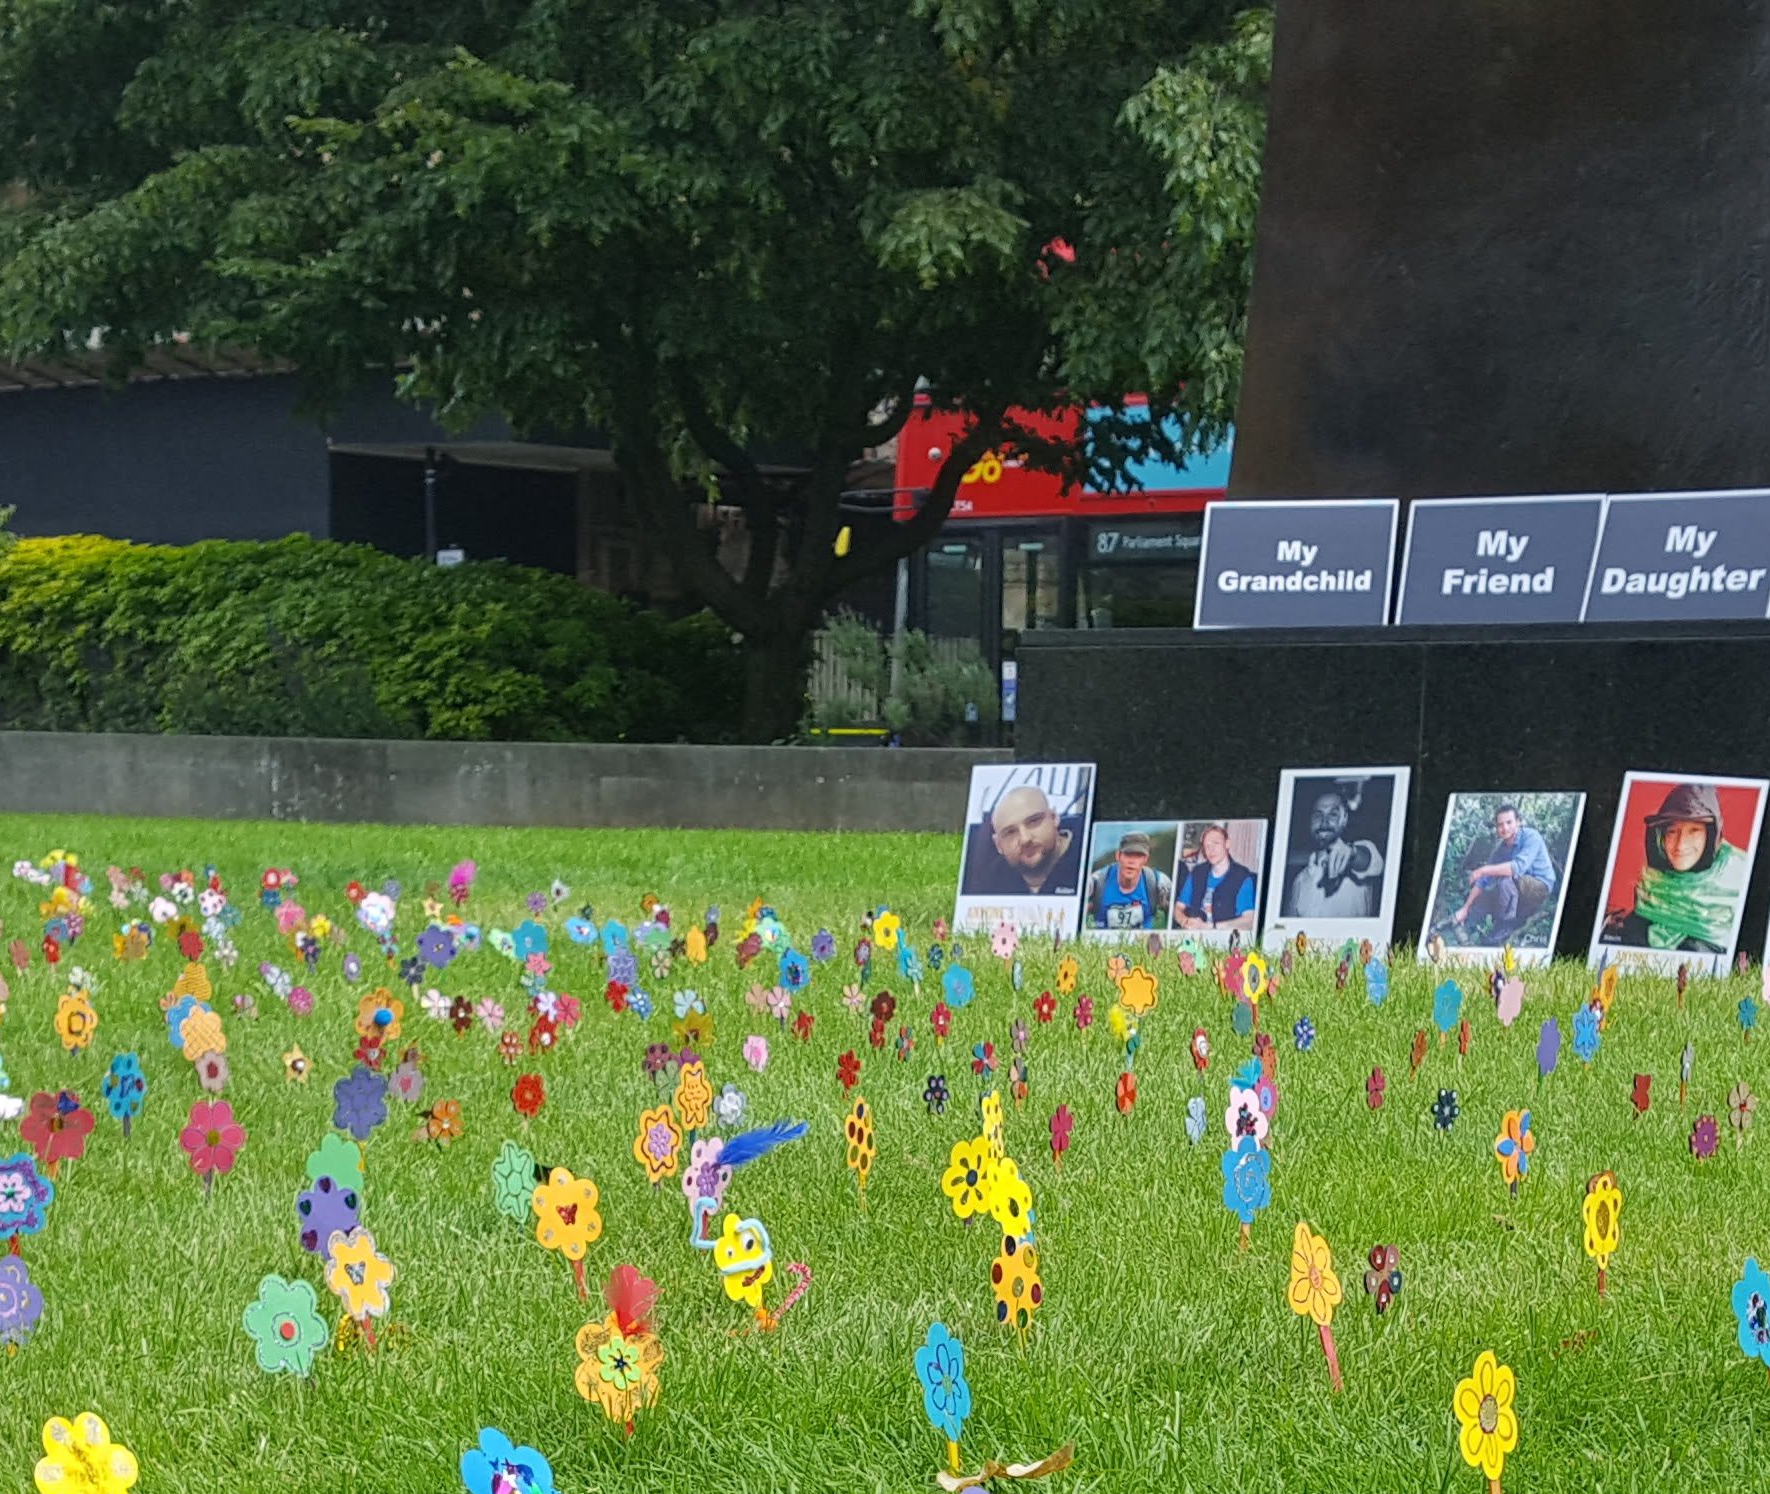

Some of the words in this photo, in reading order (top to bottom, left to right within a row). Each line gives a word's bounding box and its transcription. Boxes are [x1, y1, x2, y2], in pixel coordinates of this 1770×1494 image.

[1096, 531, 1120, 554] 87
[1276, 540, 1318, 566] My
[1476, 529, 1529, 562] My
[1663, 525, 1718, 558] My
[1217, 570, 1372, 591] Grandchild
[1441, 566, 1555, 594] Friend
[1600, 564, 1767, 599] Daughter
[1117, 911, 1133, 926] 97
